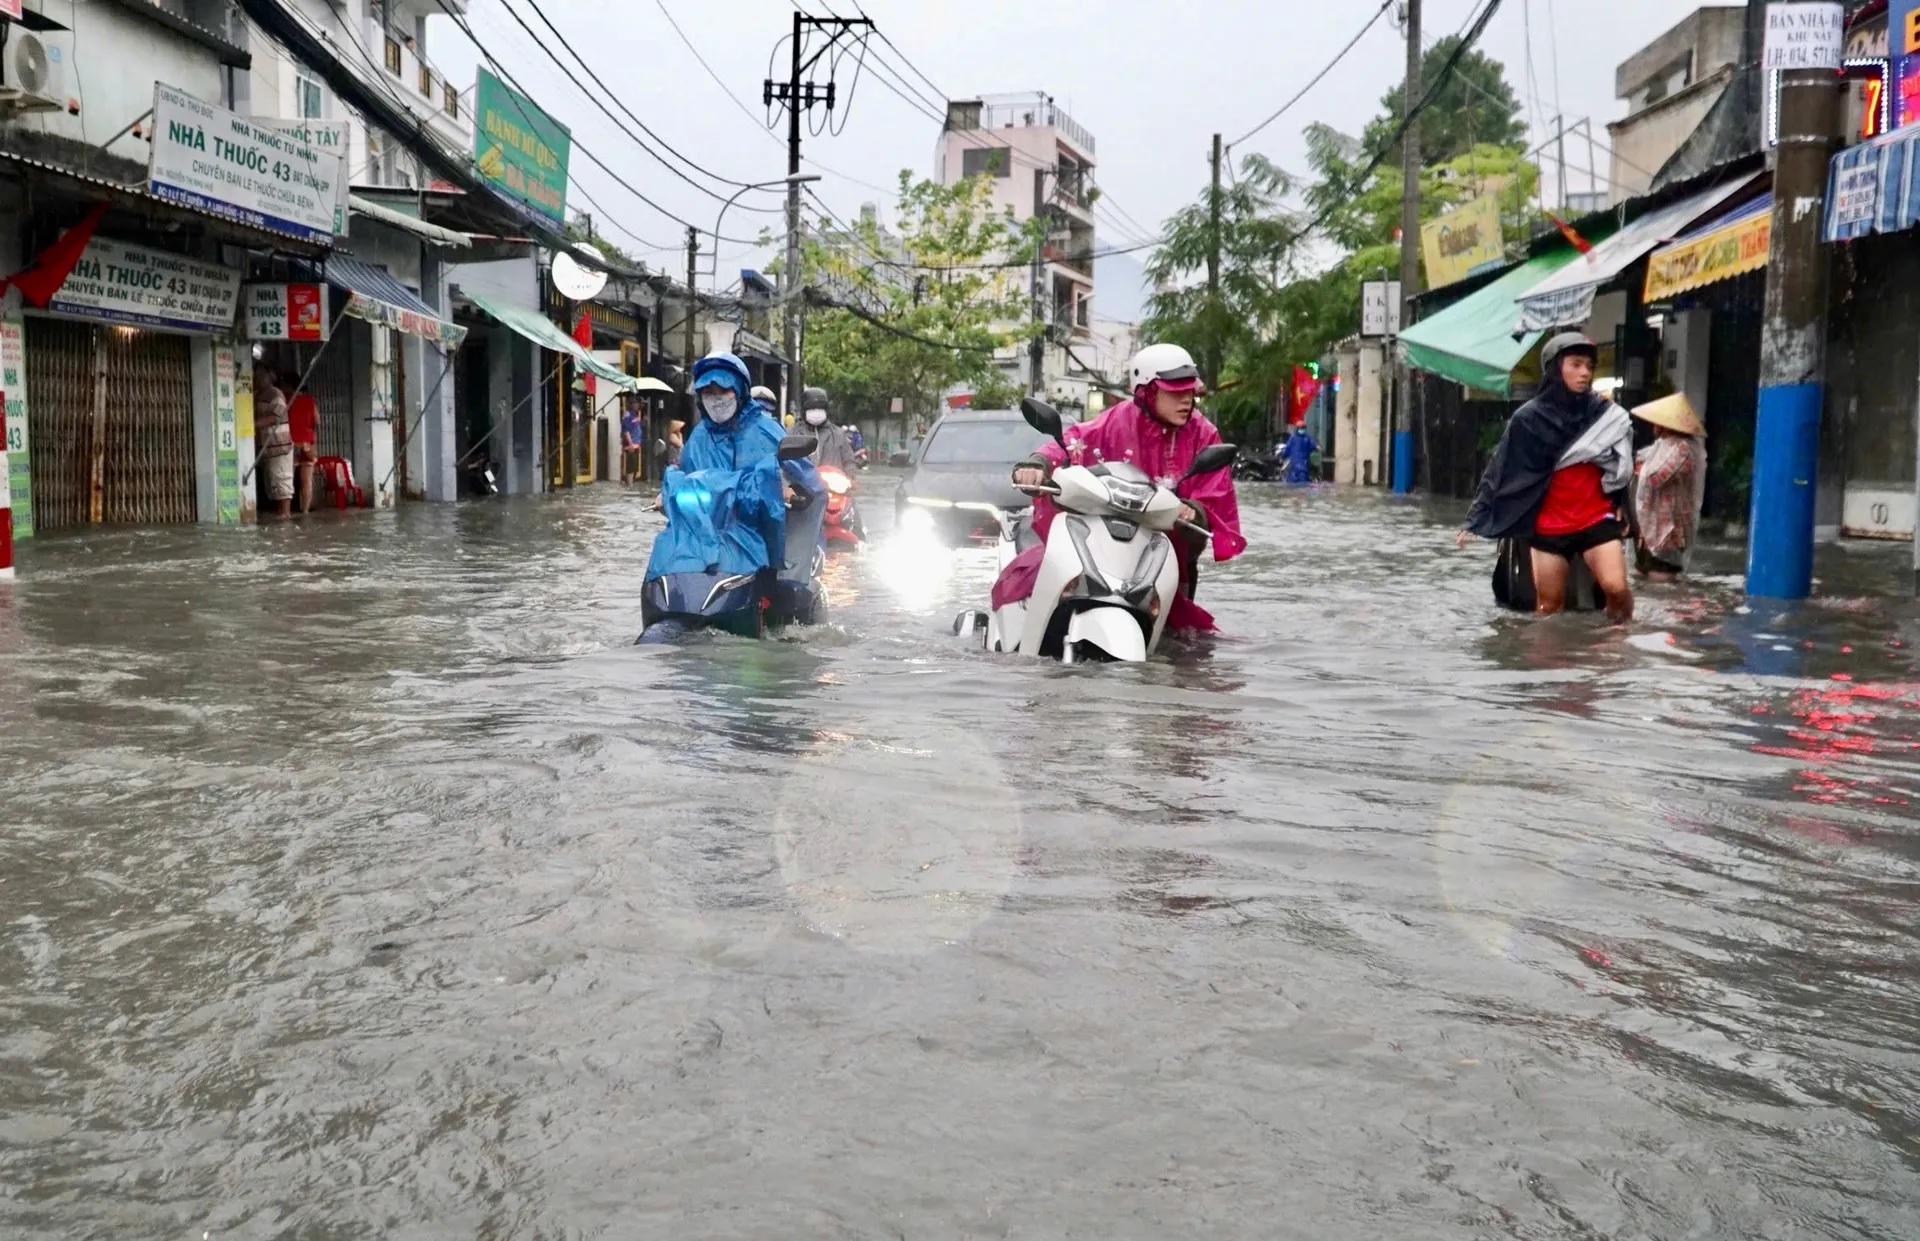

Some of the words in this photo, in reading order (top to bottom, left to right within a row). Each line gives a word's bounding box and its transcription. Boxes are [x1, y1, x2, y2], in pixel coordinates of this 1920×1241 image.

[315, 126, 340, 146] TÂY
[486, 109, 520, 149] BÁNH
[168, 120, 206, 152] NHÀ
[213, 135, 268, 175] THUỐC
[272, 160, 291, 182] 43
[192, 159, 225, 181] CHUYÊN
[107, 264, 163, 290] THUỐC
[167, 277, 187, 295] 43
[256, 287, 279, 301] NHÀ
[250, 302, 286, 317] THUỐC
[256, 321, 282, 335] 43
[8, 427, 22, 449] 43
[222, 430, 231, 448] 43
